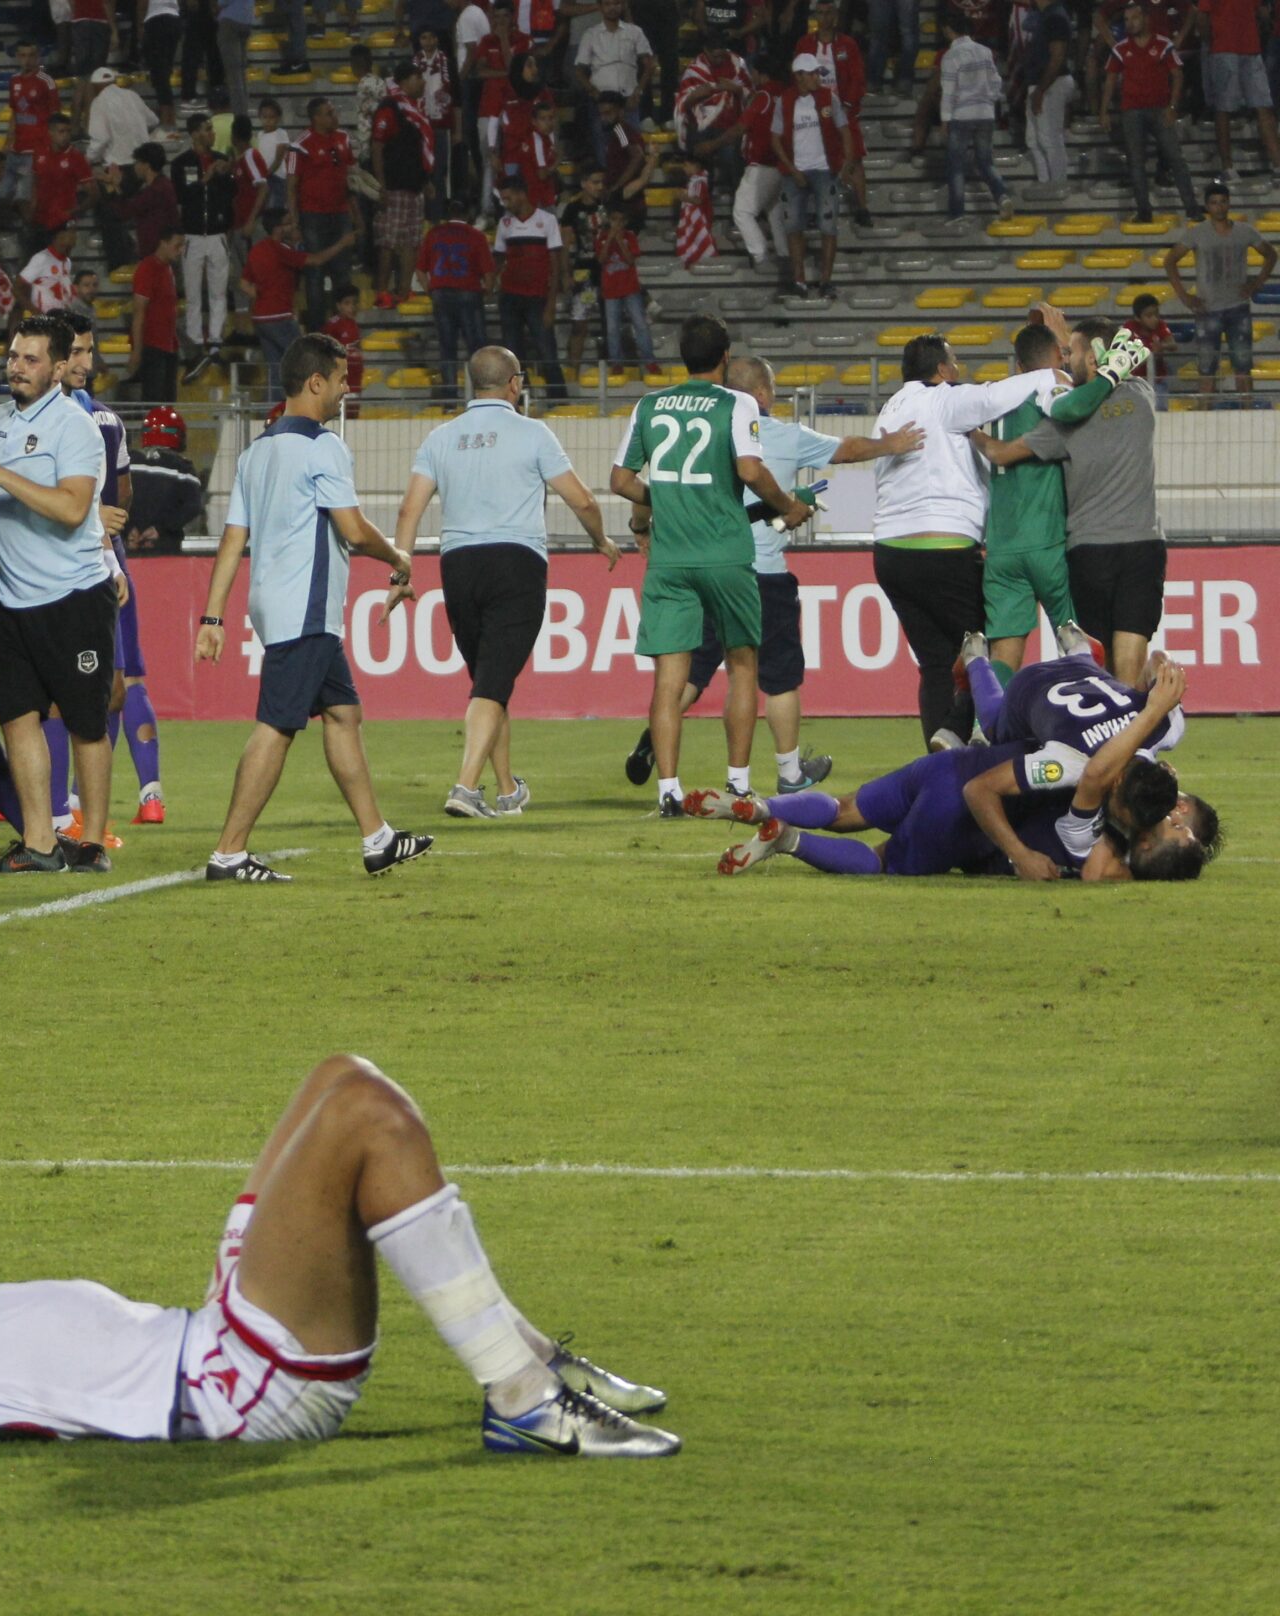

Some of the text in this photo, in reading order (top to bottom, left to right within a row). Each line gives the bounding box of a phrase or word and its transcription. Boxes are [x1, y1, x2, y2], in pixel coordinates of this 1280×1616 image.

[654, 395, 718, 412] BOULTIF
[649, 414, 713, 484] 22
[1047, 676, 1132, 717] 13
